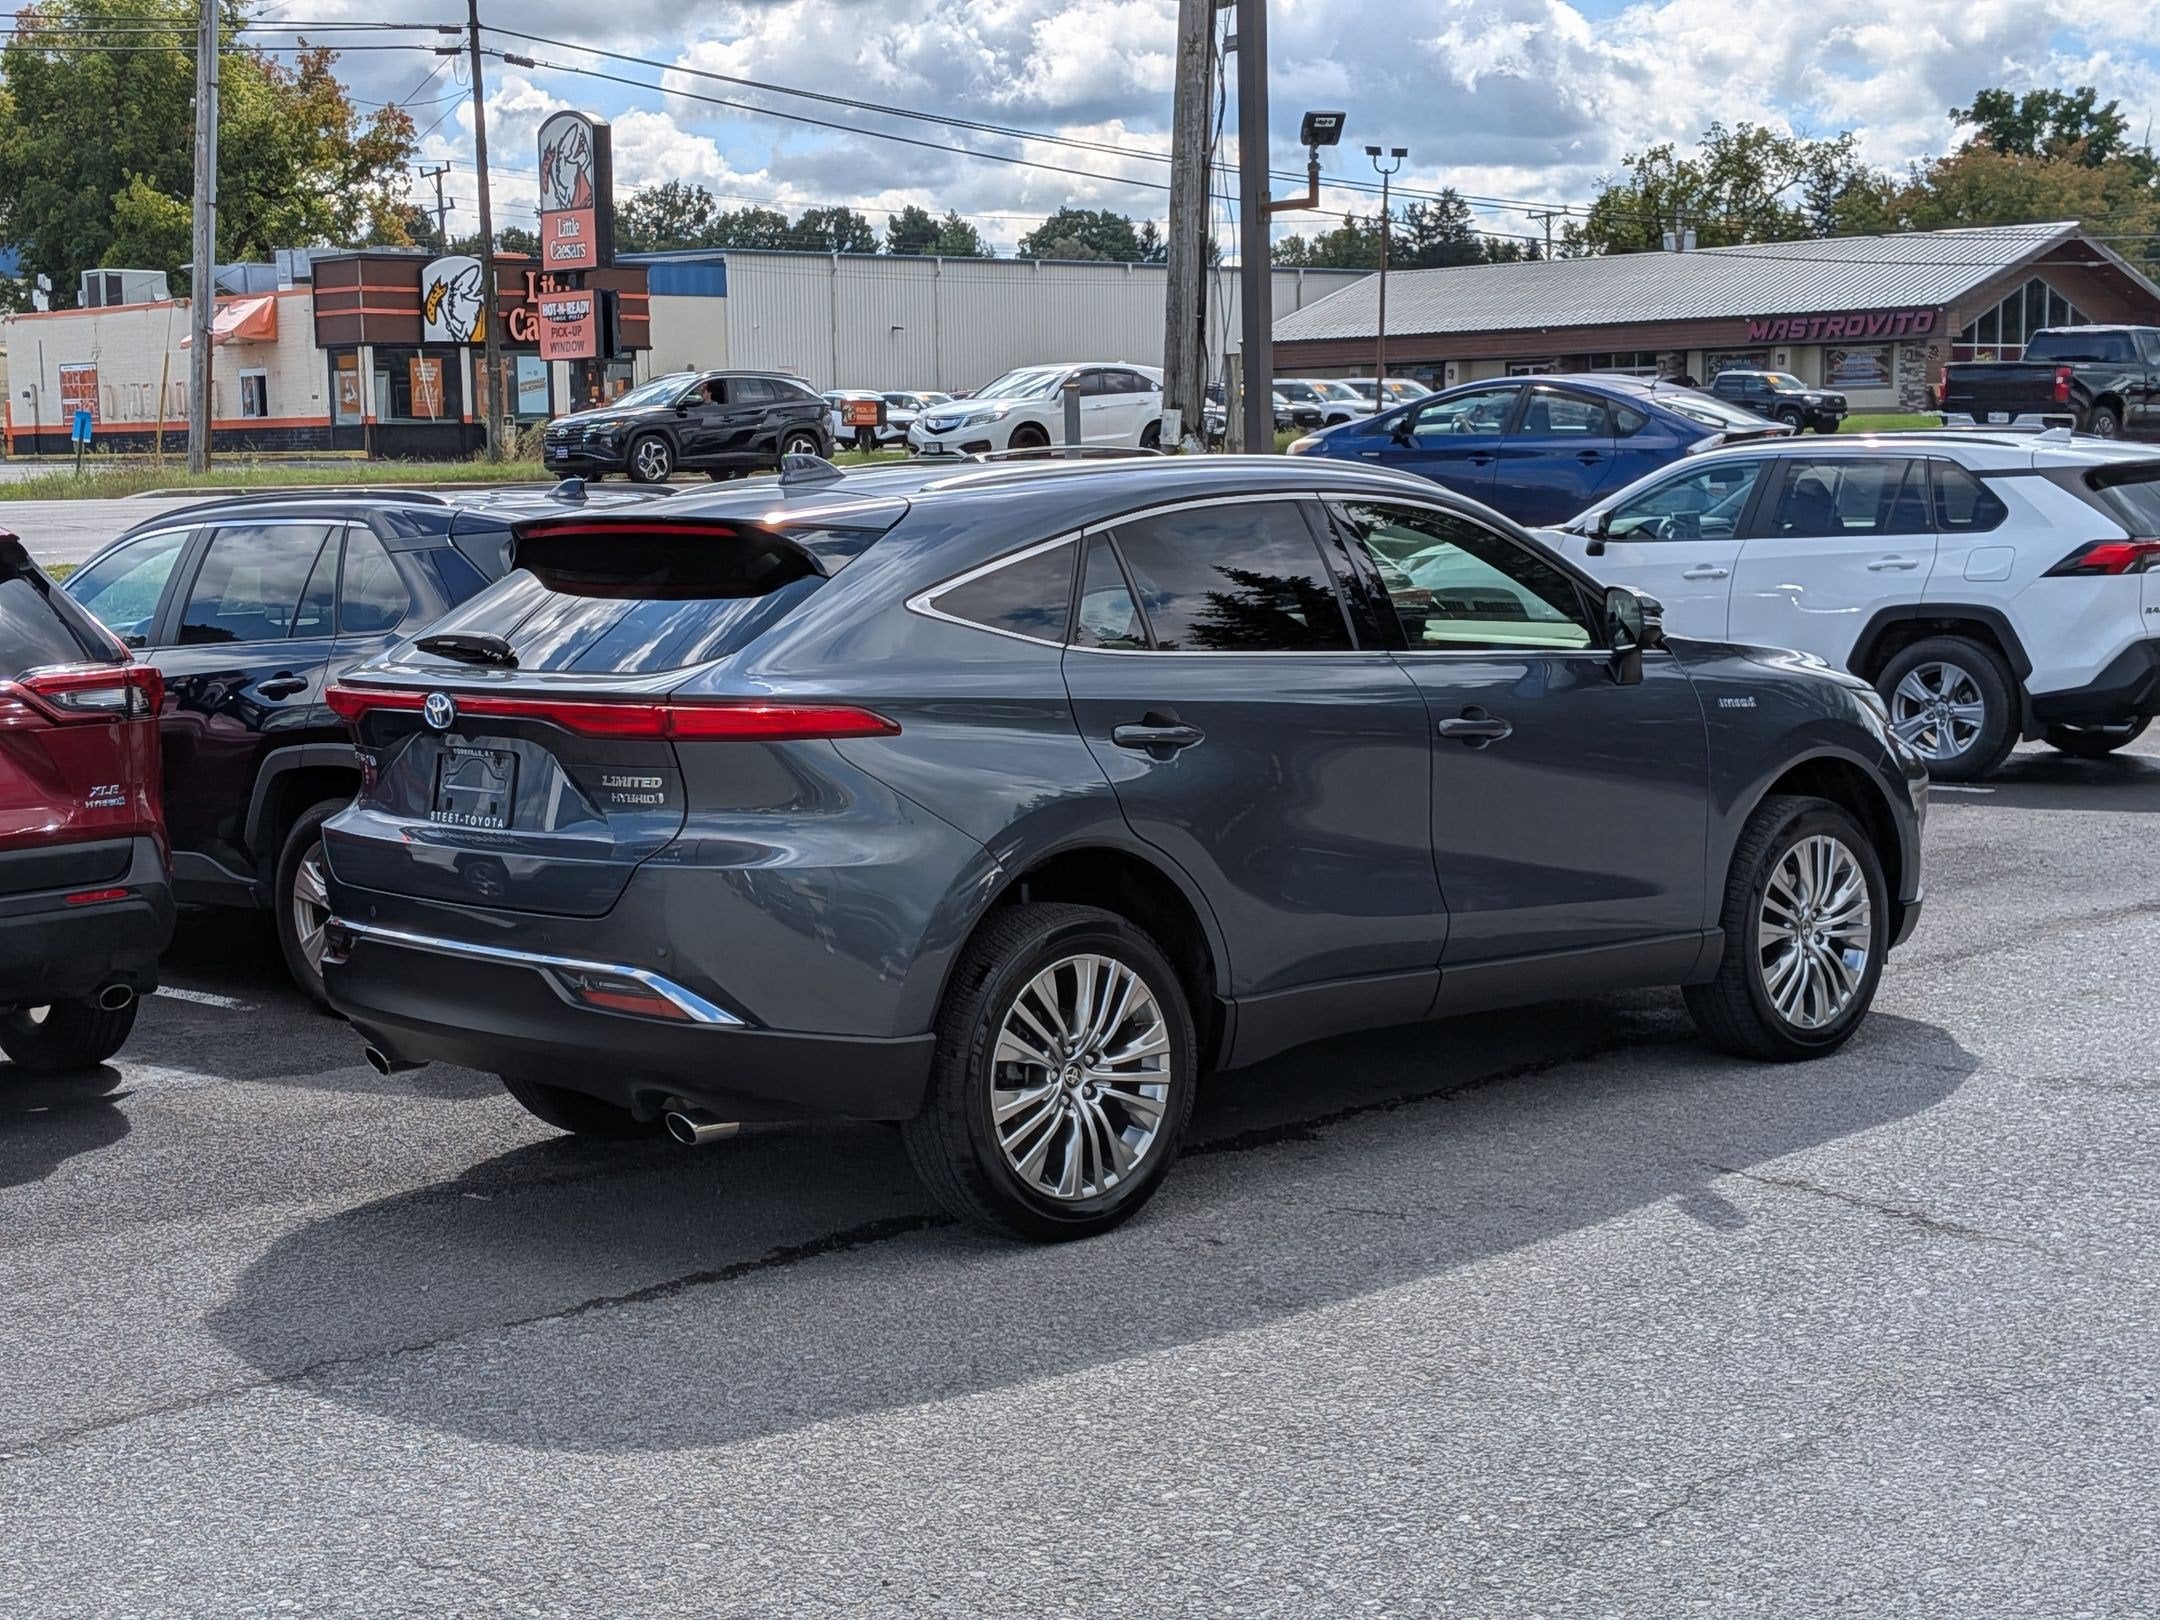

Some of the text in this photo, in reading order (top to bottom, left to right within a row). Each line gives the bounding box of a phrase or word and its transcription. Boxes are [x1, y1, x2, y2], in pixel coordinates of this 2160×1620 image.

[556, 217, 580, 237] Little
[550, 241, 586, 261] Caesars
[541, 300, 591, 317] HOT-N-READY
[551, 324, 582, 339] PICK-UP
[1747, 310, 1935, 340] MASTROVITO
[549, 340, 585, 353] WINDOW
[602, 775, 662, 788] LIMITED
[89, 784, 119, 797] XLE
[611, 792, 655, 804] HYBRID
[430, 811, 504, 828] STEET-TOYOTA
